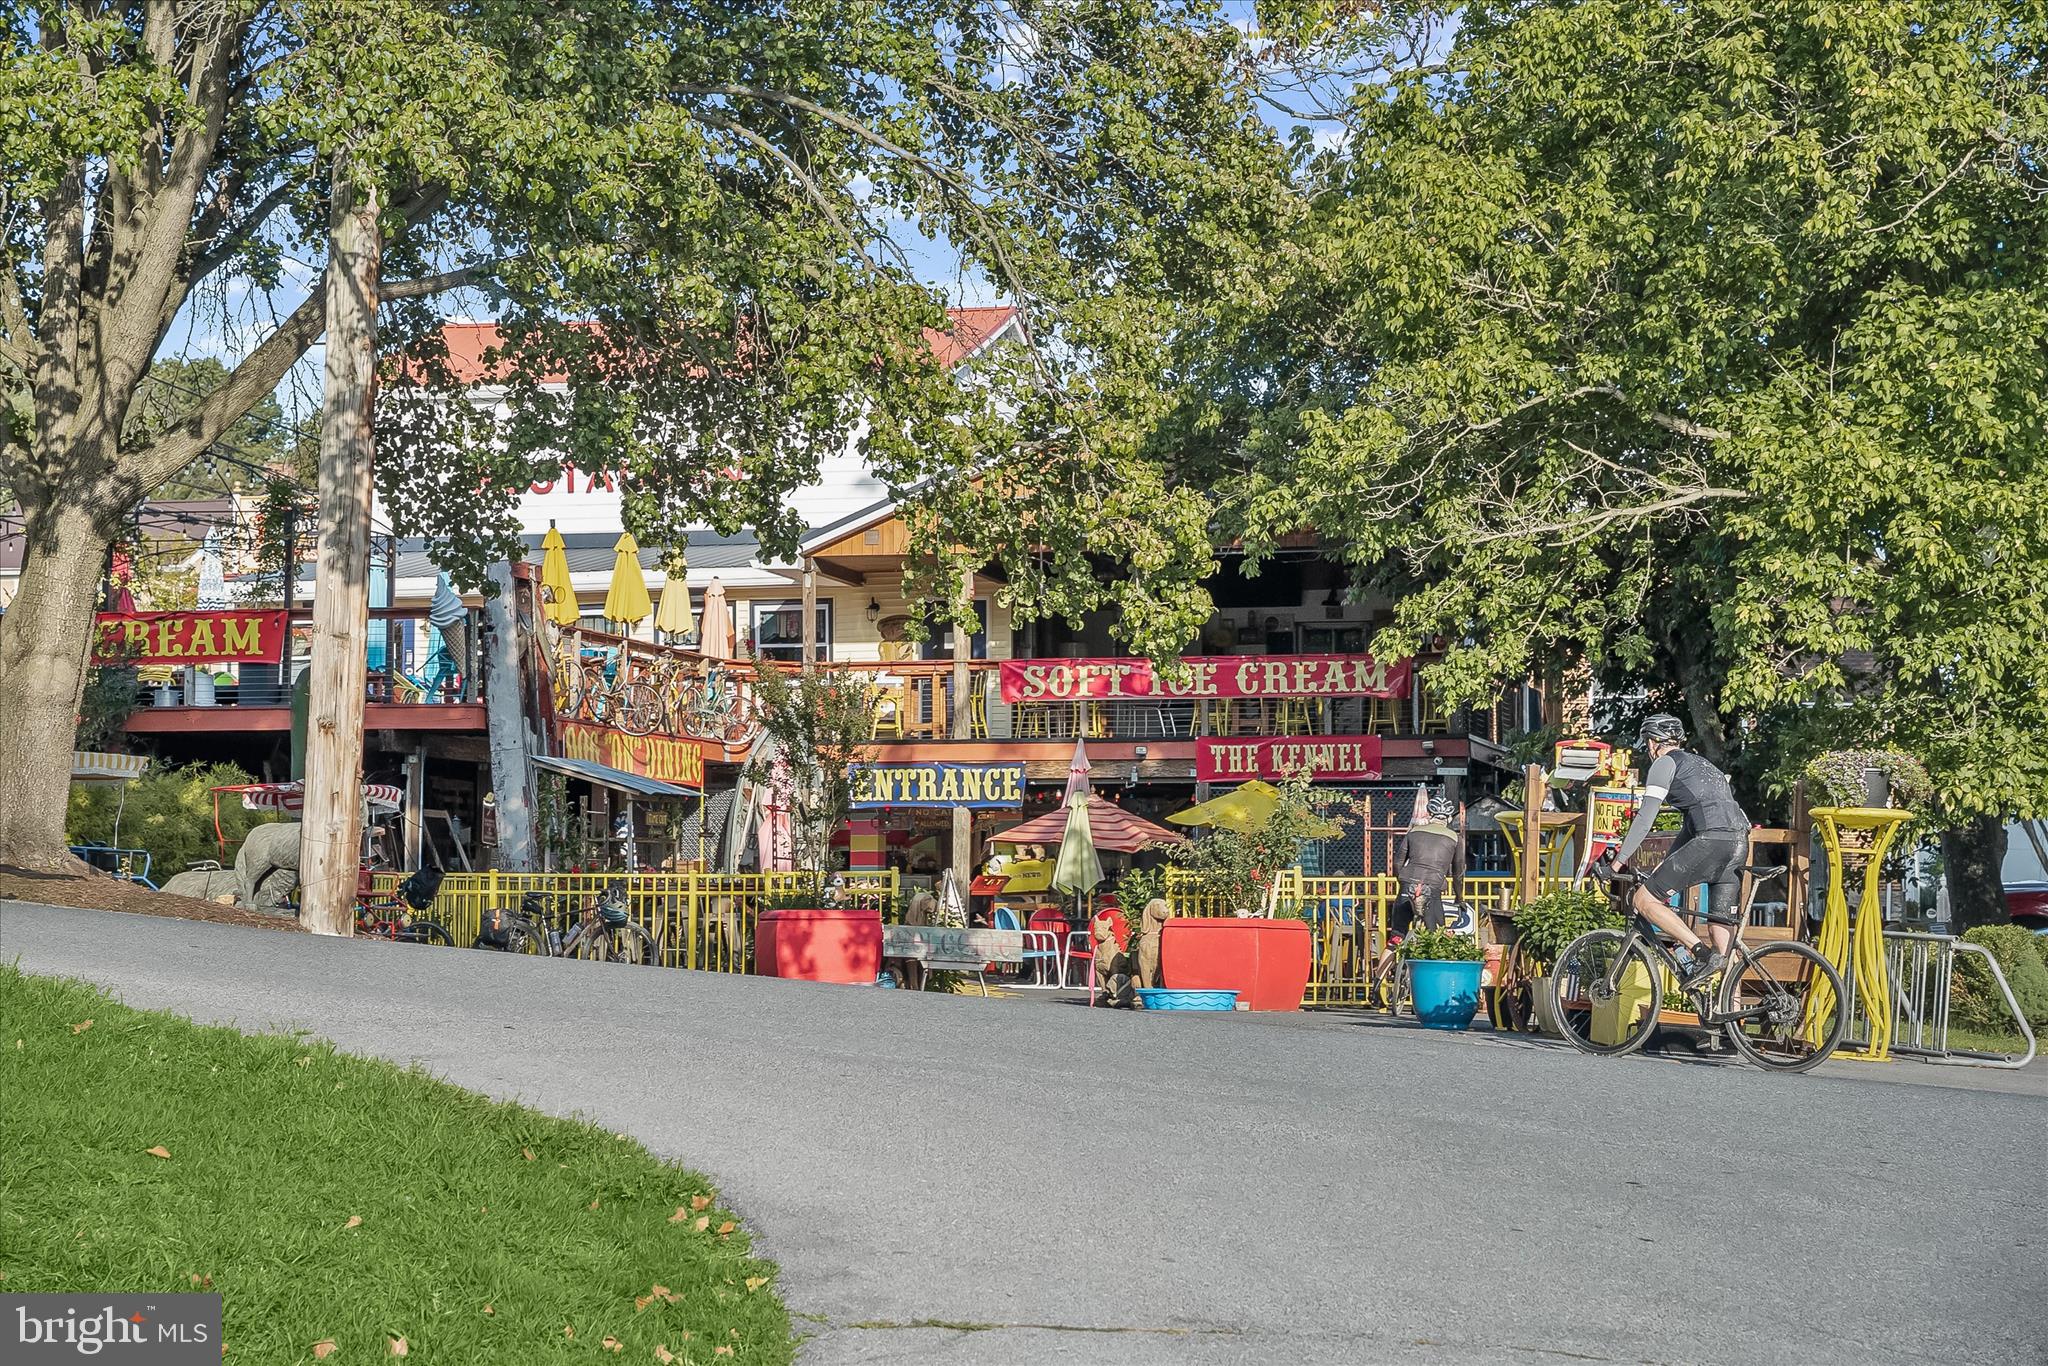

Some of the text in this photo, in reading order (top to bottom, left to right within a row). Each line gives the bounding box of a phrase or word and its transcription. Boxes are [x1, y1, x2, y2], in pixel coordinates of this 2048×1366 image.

[97, 617, 264, 657] CREAM
[1022, 660, 1390, 698] SOFT ICE CREAM
[644, 736, 702, 783] DINING
[1210, 743, 1368, 773] THE KENNEL
[852, 767, 1022, 802] ENTRANCE
[1595, 803, 1605, 816] NO
[1597, 817, 1609, 830] ON
